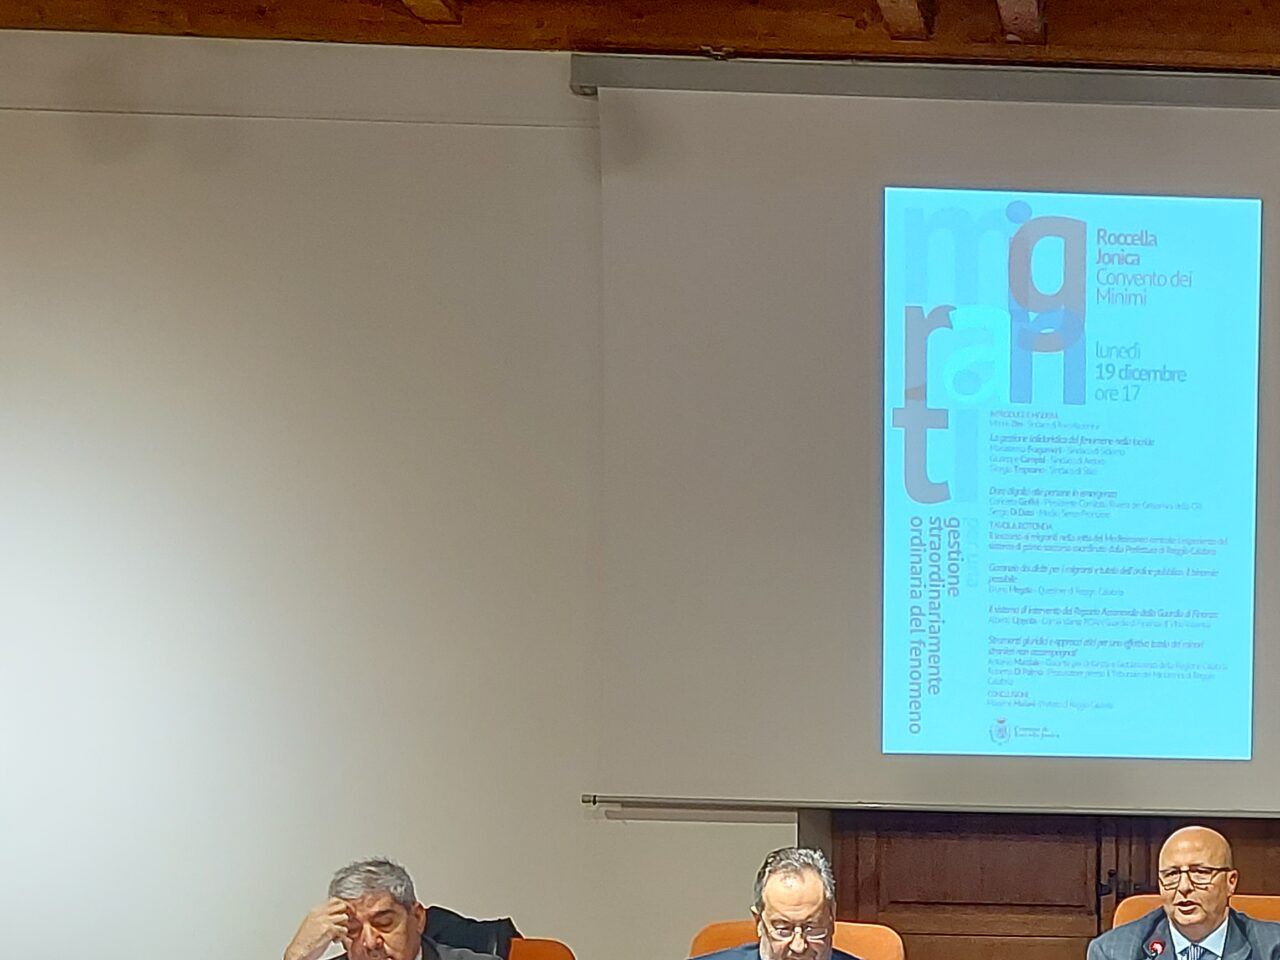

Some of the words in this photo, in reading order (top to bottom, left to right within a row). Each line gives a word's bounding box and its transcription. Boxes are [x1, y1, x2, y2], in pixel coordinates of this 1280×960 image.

[1097, 228, 1157, 247] Roccella
[1096, 248, 1140, 265] Jonica
[1097, 267, 1167, 287] Convento
[1170, 270, 1193, 288] dei
[1097, 287, 1147, 306] Minimi
[1095, 363, 1116, 380] 19
[1118, 364, 1188, 382] dicembre
[909, 516, 927, 599] ordinaria
[943, 516, 964, 598] gestione
[927, 516, 946, 697] straordinariamente
[909, 605, 926, 634] del
[908, 639, 926, 735] fenomeno
